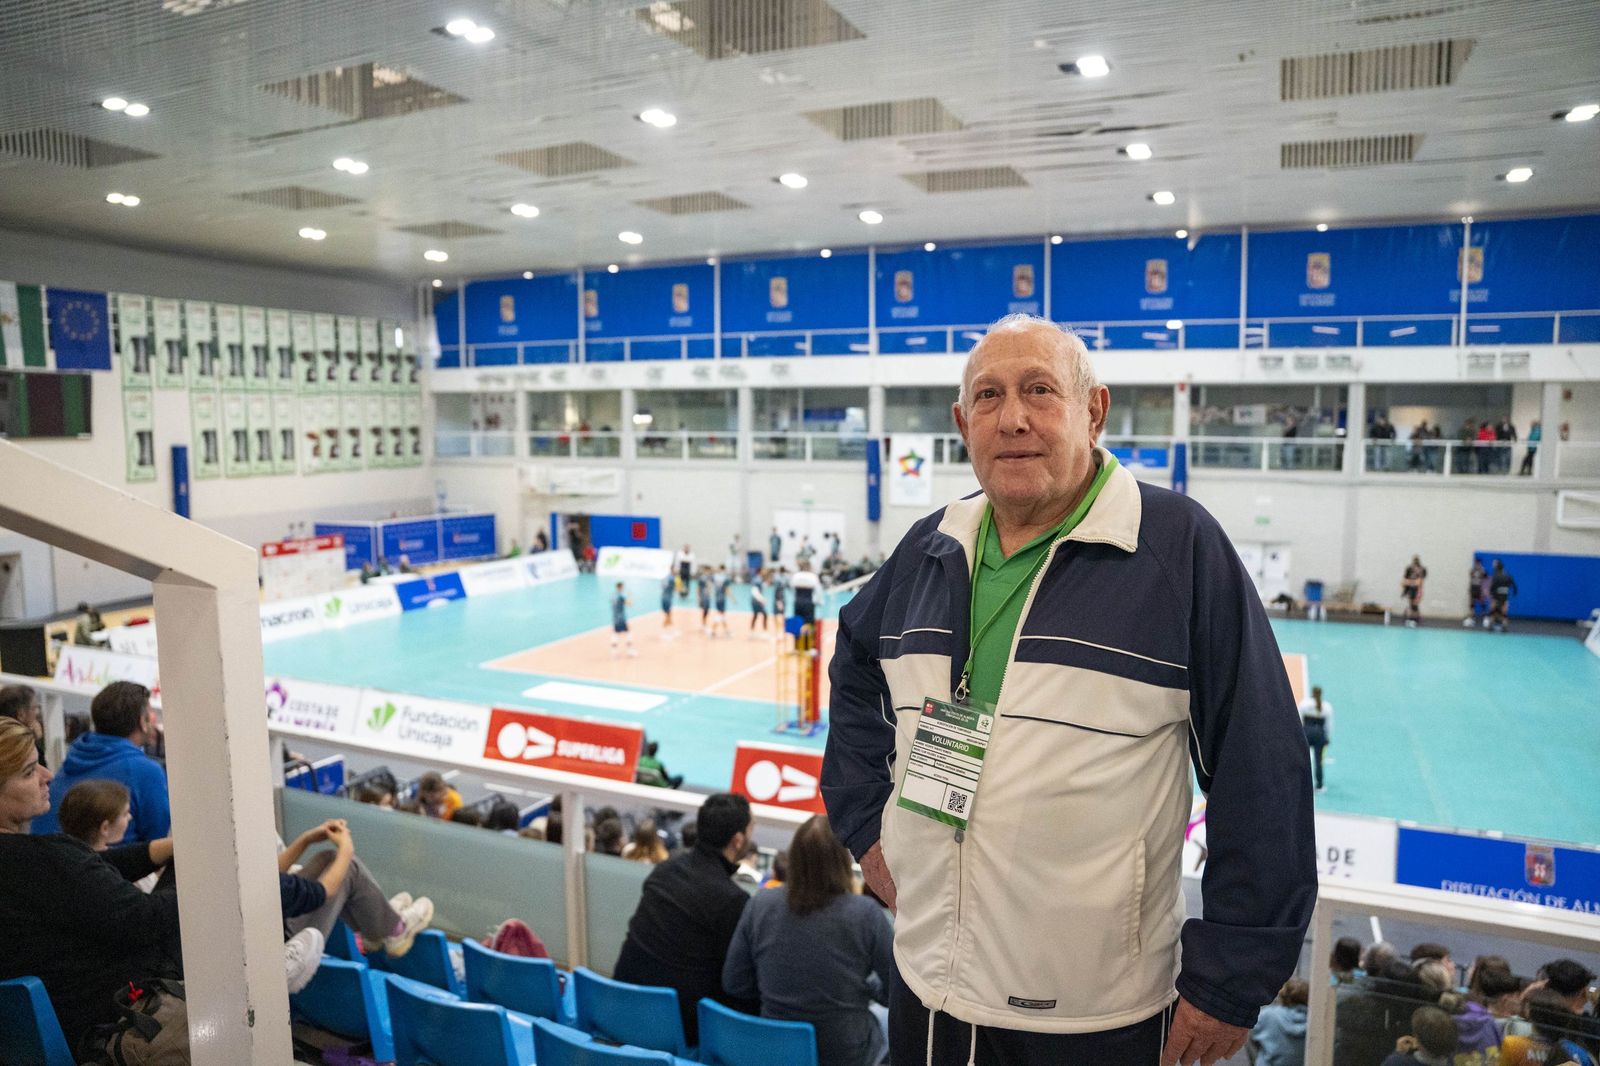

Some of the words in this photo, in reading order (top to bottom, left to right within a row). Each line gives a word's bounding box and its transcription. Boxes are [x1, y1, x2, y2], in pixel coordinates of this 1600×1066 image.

[401, 705, 479, 731] Fundación
[399, 725, 453, 751] Unicaja
[932, 734, 969, 751] VOLUNTARIO
[556, 739, 626, 765] SUPERLIGA
[1327, 847, 1356, 866] DE
[1441, 879, 1541, 905] DIPUTACIÓN
